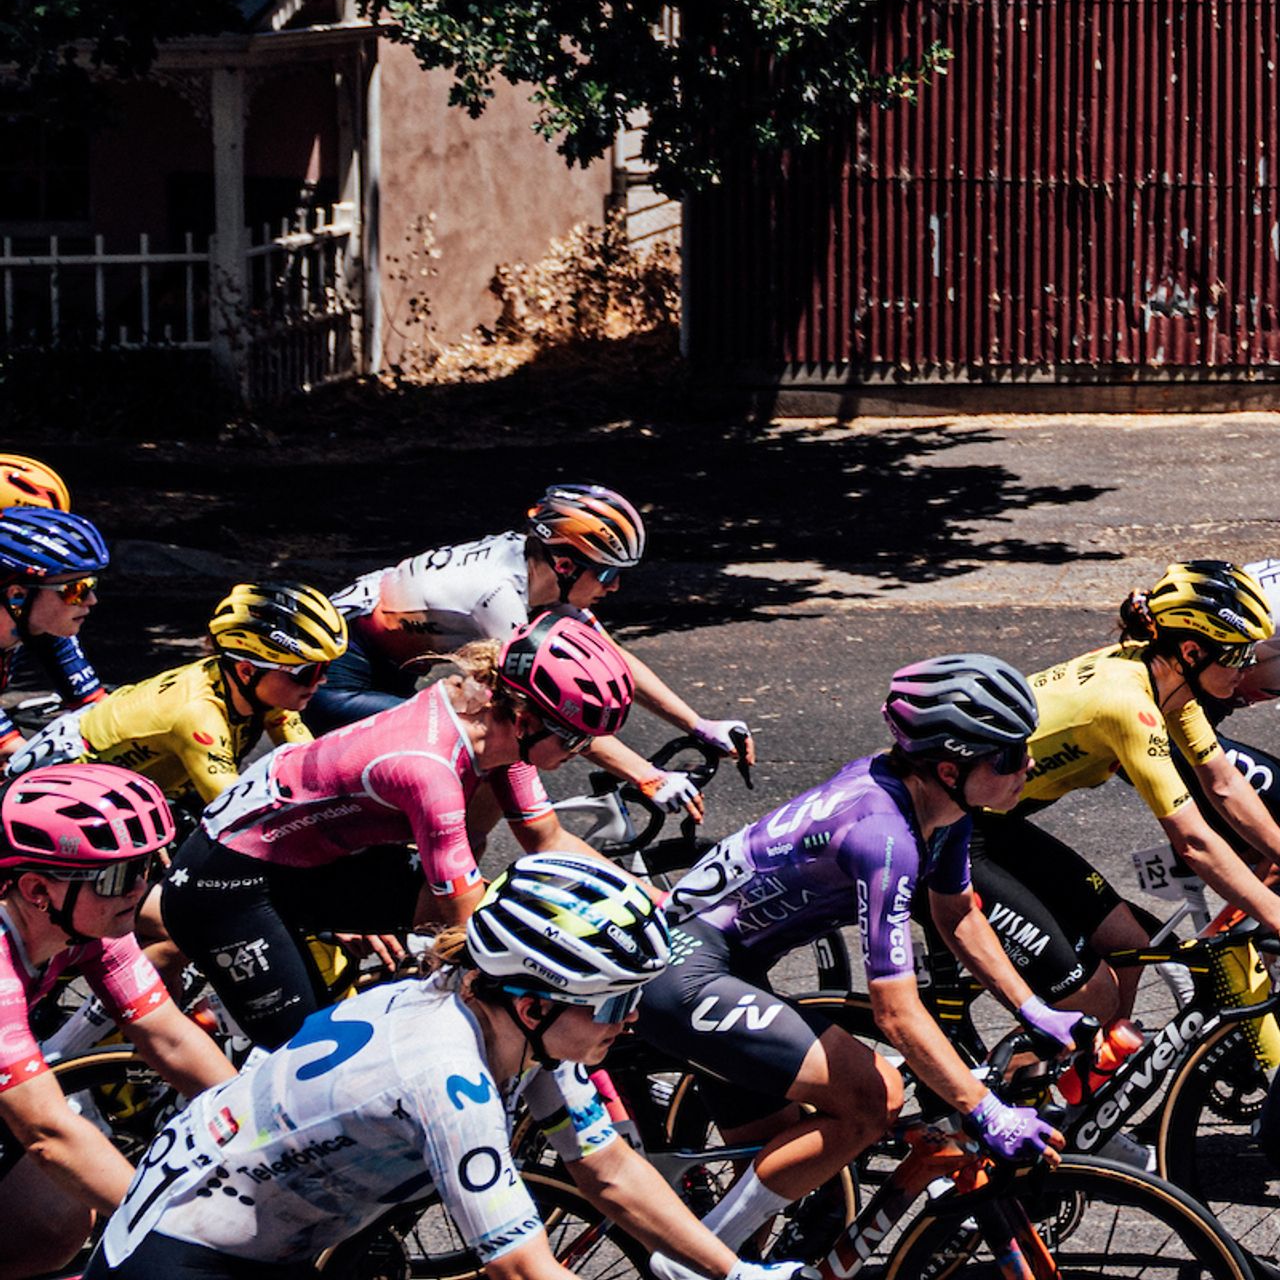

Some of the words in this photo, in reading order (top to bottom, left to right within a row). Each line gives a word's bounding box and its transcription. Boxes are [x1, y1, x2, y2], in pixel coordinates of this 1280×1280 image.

[505, 652, 535, 677] EF
[944, 738, 975, 758] Liv
[260, 802, 363, 844] cannondale
[766, 790, 846, 839] Liv
[196, 876, 265, 890] easypost
[1145, 854, 1170, 890] 121
[988, 902, 1051, 956] VISMA
[528, 960, 564, 985] ABUS
[691, 993, 784, 1032] Liv
[1200, 1030, 1243, 1073] RESER
[1076, 1010, 1205, 1151] cervélo
[236, 1134, 358, 1185] Telefónica
